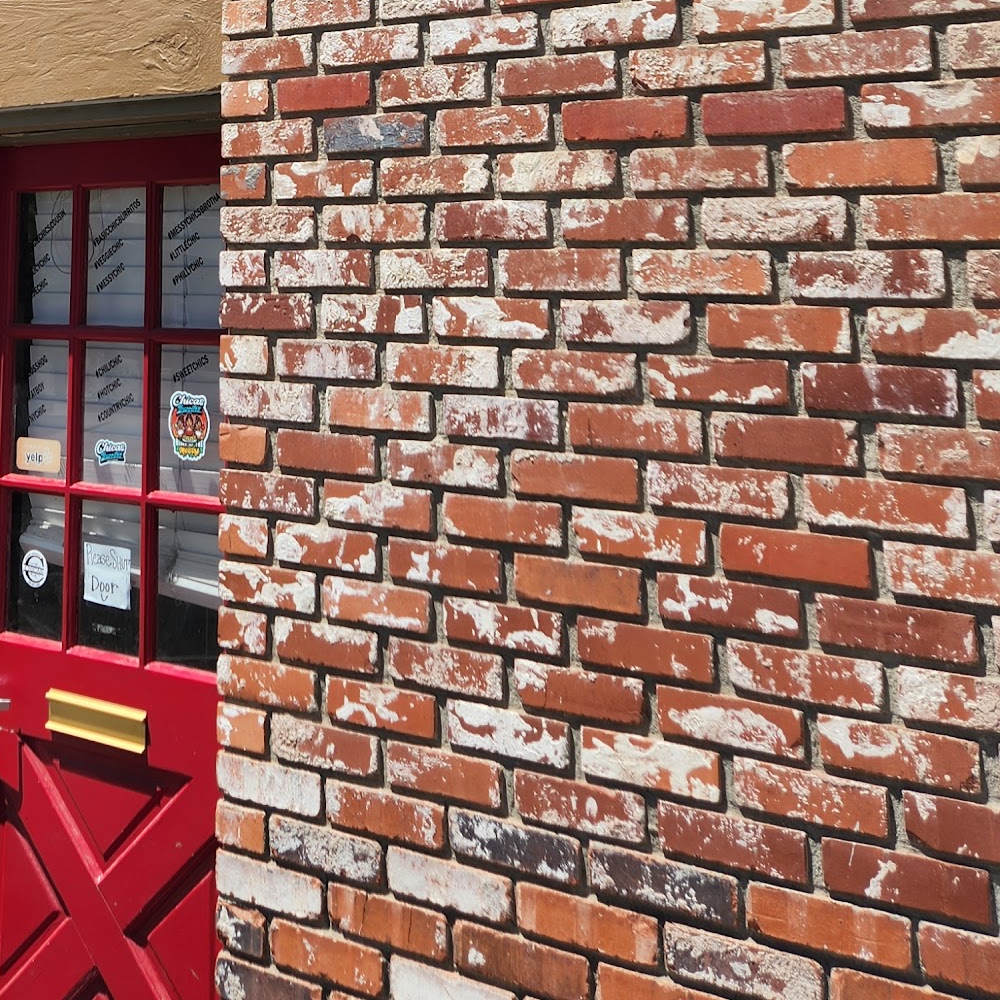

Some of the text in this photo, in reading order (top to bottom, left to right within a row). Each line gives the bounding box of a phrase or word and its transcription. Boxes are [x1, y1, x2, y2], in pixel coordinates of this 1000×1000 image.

[94, 238, 124, 270] #VEGGIECHIC
[169, 232, 200, 261] #LITTLECHIC
[95, 262, 125, 293] #MESSYCHIC
[172, 256, 204, 286] #PHILLYCHIC
[172, 354, 210, 383] #SWEETCHICS
[97, 378, 122, 399] #HOTCHIC
[173, 394, 205, 406] Chicas
[97, 392, 135, 422] #COUNTRYCHIC
[26, 451, 43, 464] yelp
[86, 543, 112, 566] Please
[91, 575, 119, 594] Door
